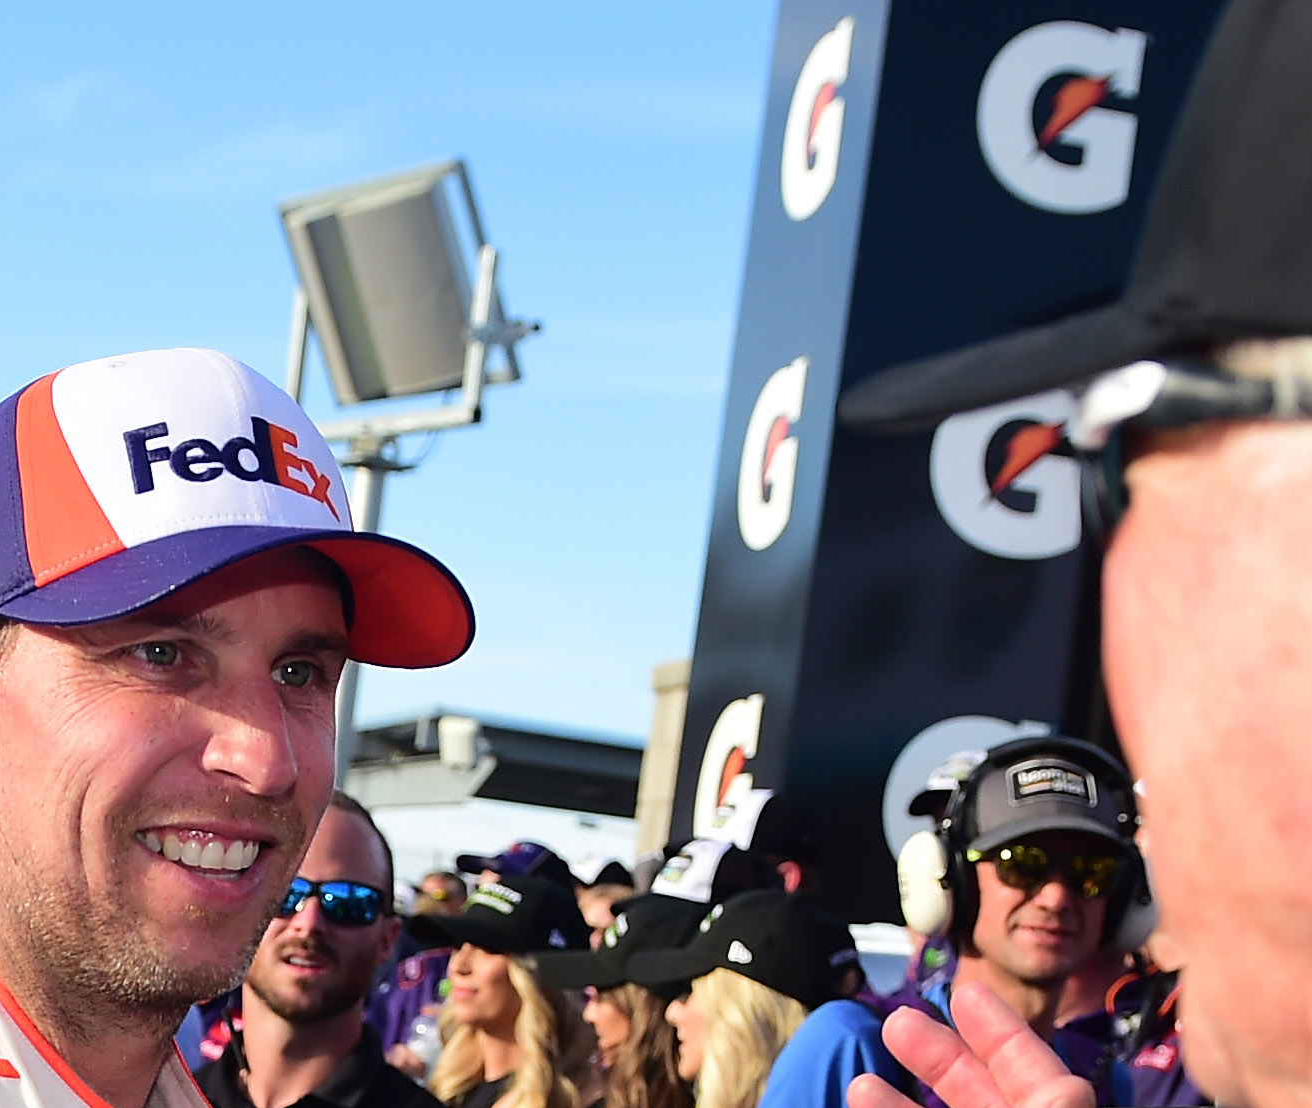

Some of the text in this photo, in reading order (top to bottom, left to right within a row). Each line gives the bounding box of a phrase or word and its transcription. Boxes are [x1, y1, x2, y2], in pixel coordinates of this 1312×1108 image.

[780, 15, 855, 221] G
[976, 19, 1148, 215] G
[123, 416, 342, 523] FedEx
[736, 356, 809, 552] G
